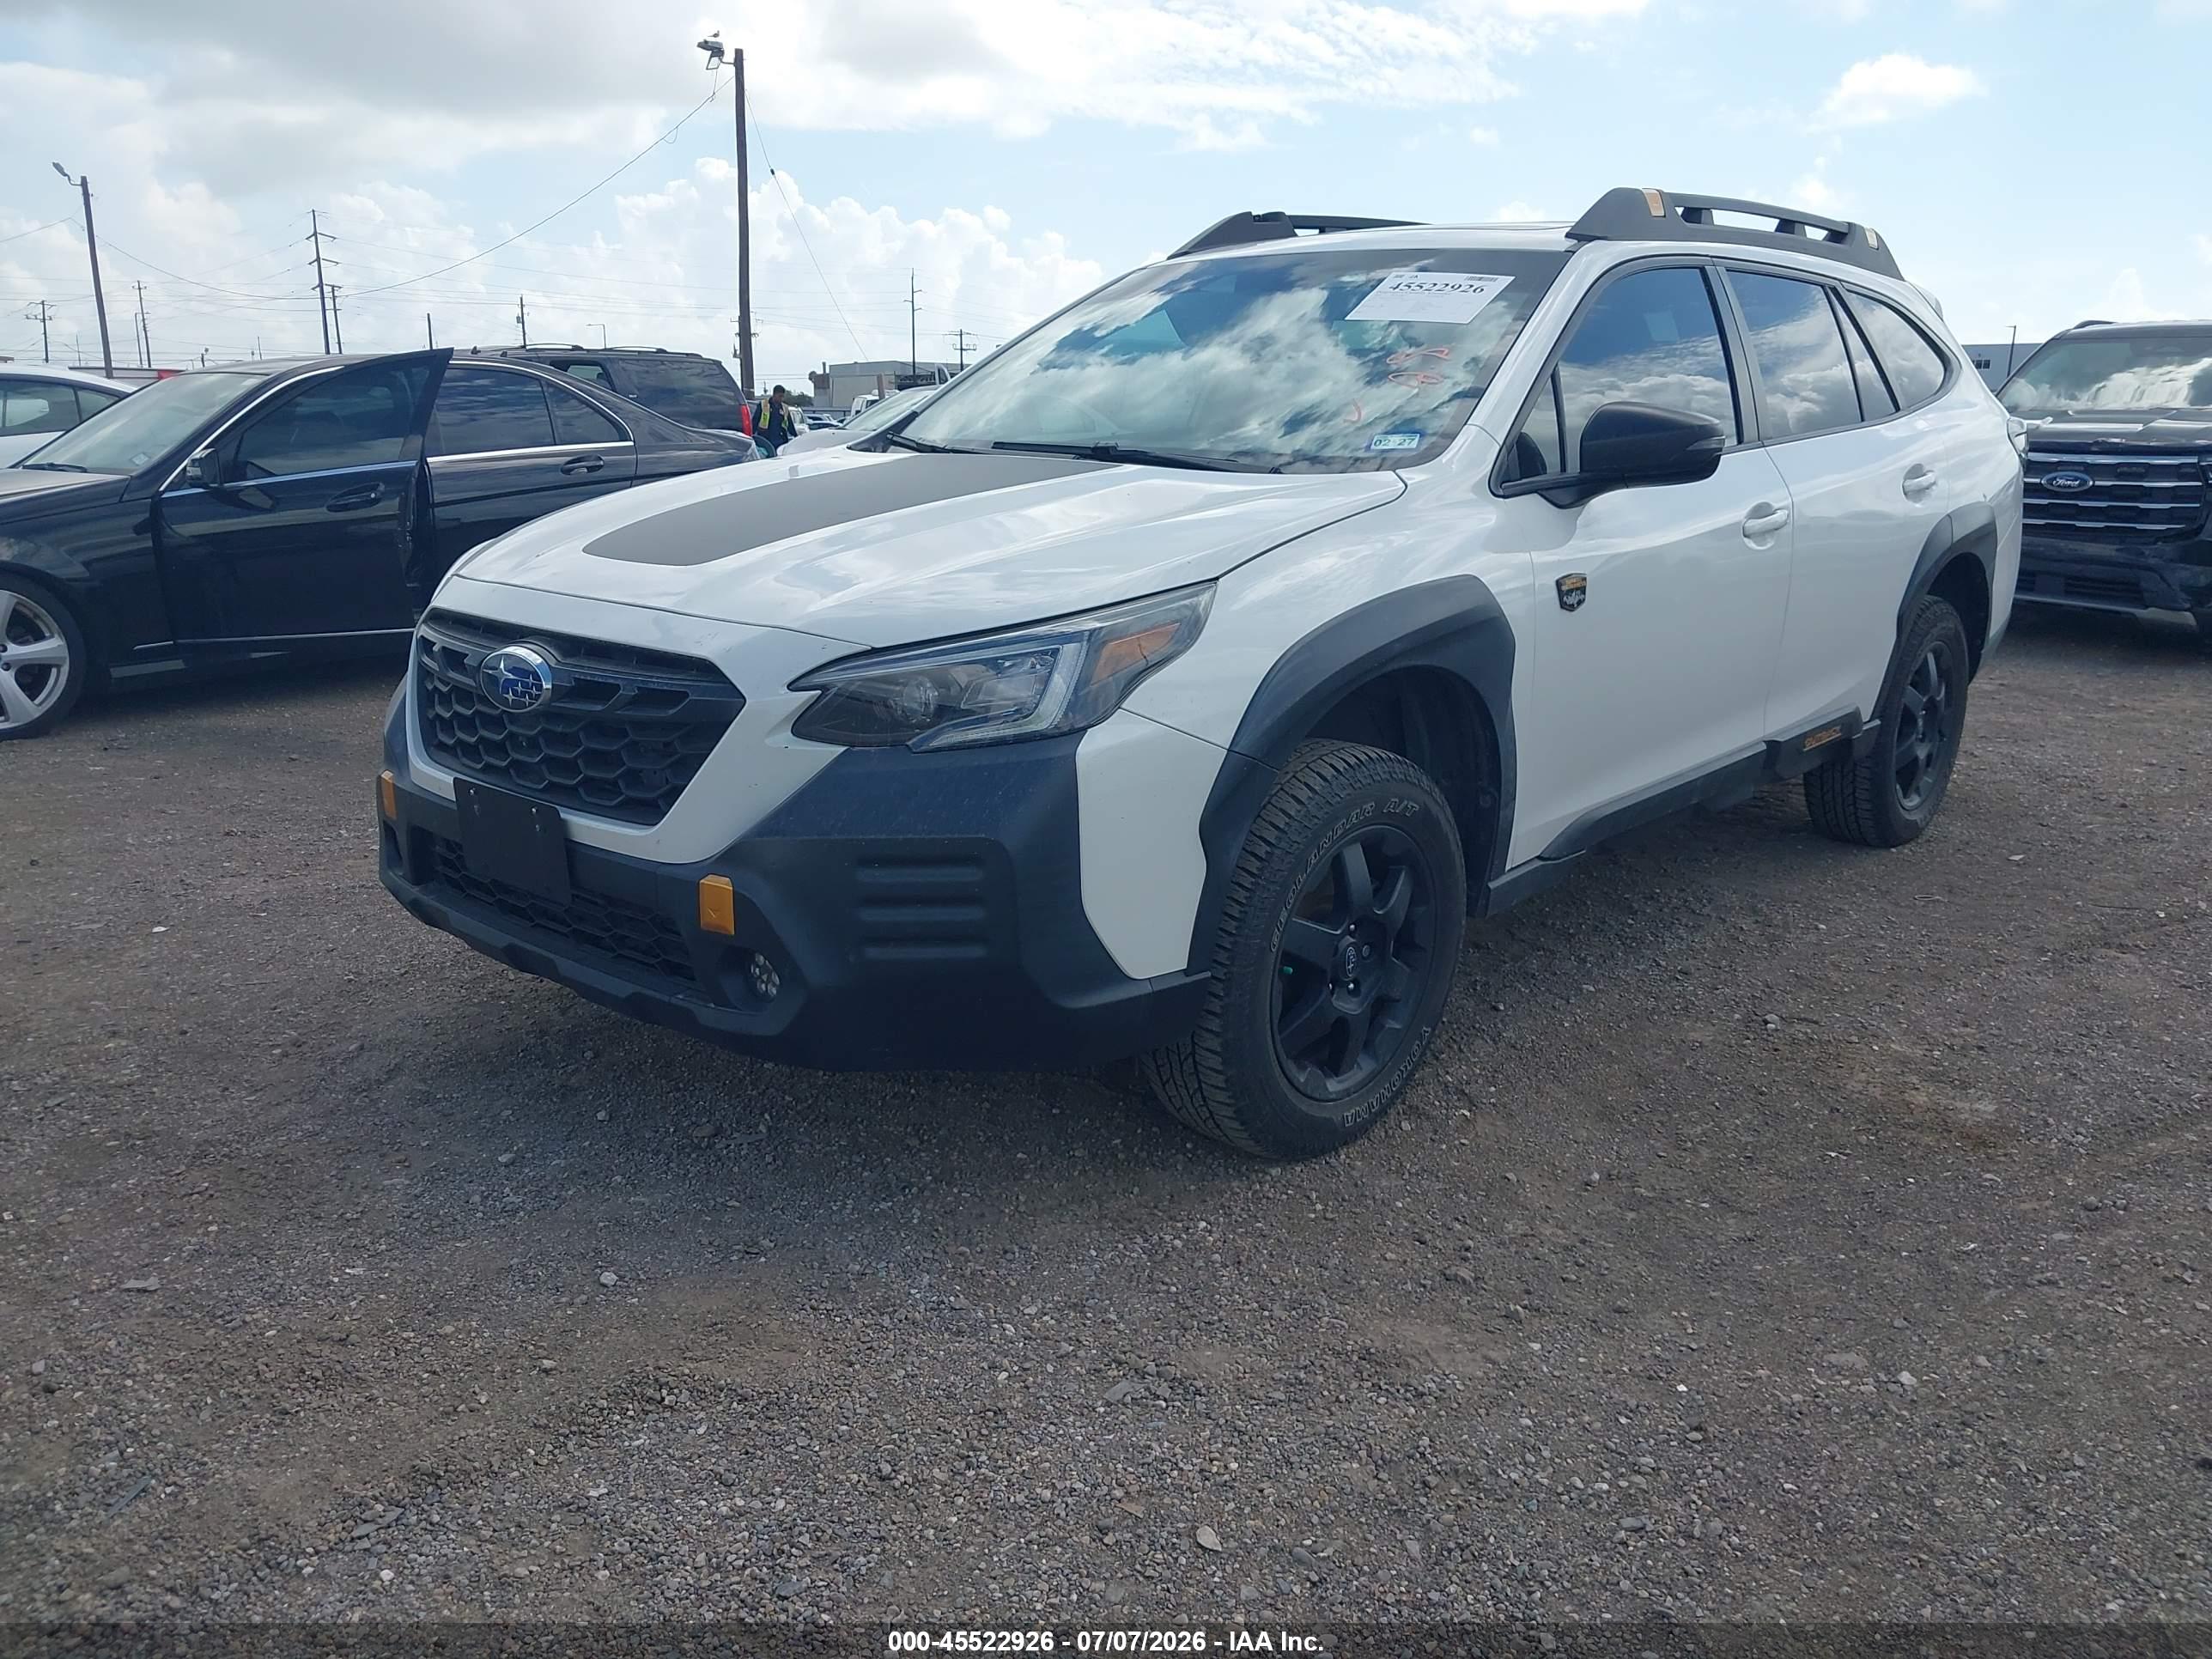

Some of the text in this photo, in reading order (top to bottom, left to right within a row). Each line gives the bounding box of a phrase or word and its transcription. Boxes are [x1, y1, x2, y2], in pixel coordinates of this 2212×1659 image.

[1389, 282, 1486, 295] 45522926
[1397, 438, 1416, 447] 27
[1271, 798, 1419, 952] GEOLANDAR A/T
[1344, 1026, 1431, 1127] YOKOHAMA
